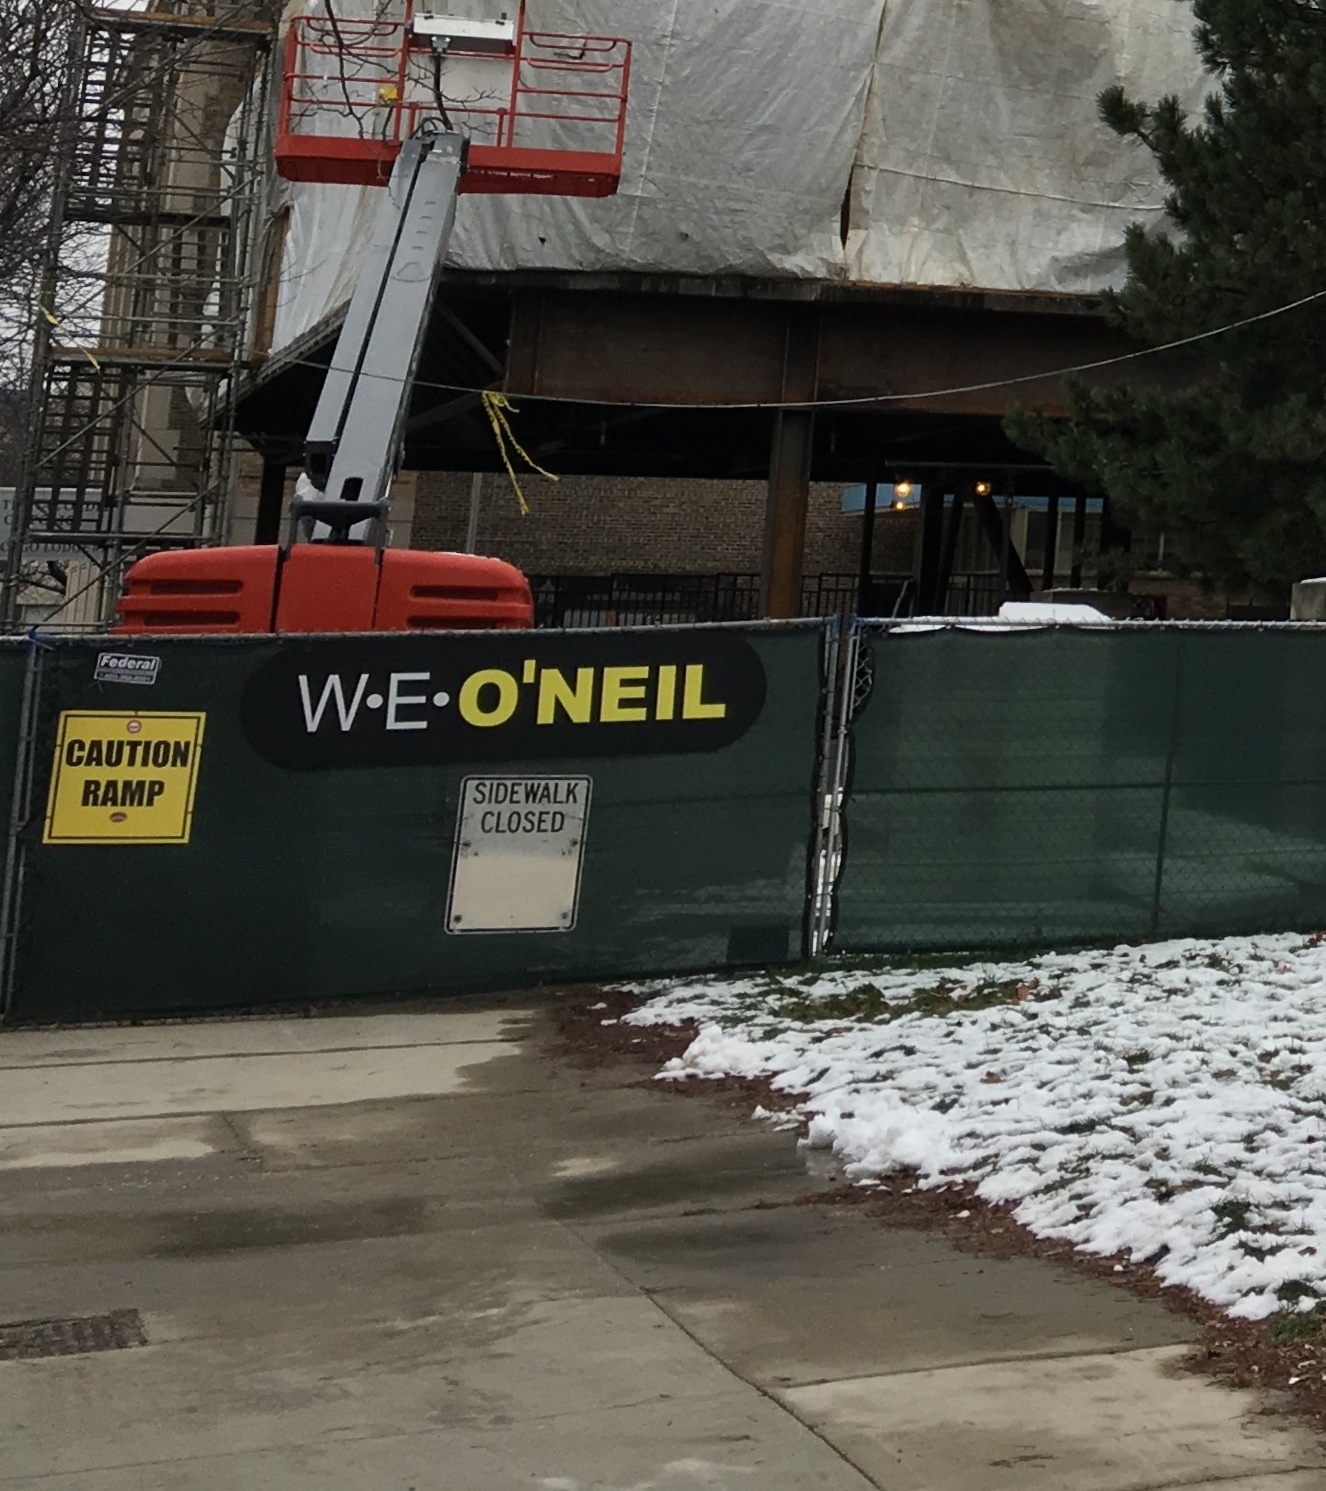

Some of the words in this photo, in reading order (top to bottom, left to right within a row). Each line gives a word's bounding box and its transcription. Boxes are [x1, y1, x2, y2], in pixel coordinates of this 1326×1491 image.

[100, 655, 156, 670] Federal
[65, 738, 192, 768] CAUTION
[81, 779, 166, 808] RAMP
[472, 781, 580, 805] SIDEWALK
[480, 810, 566, 834] CLOSED
